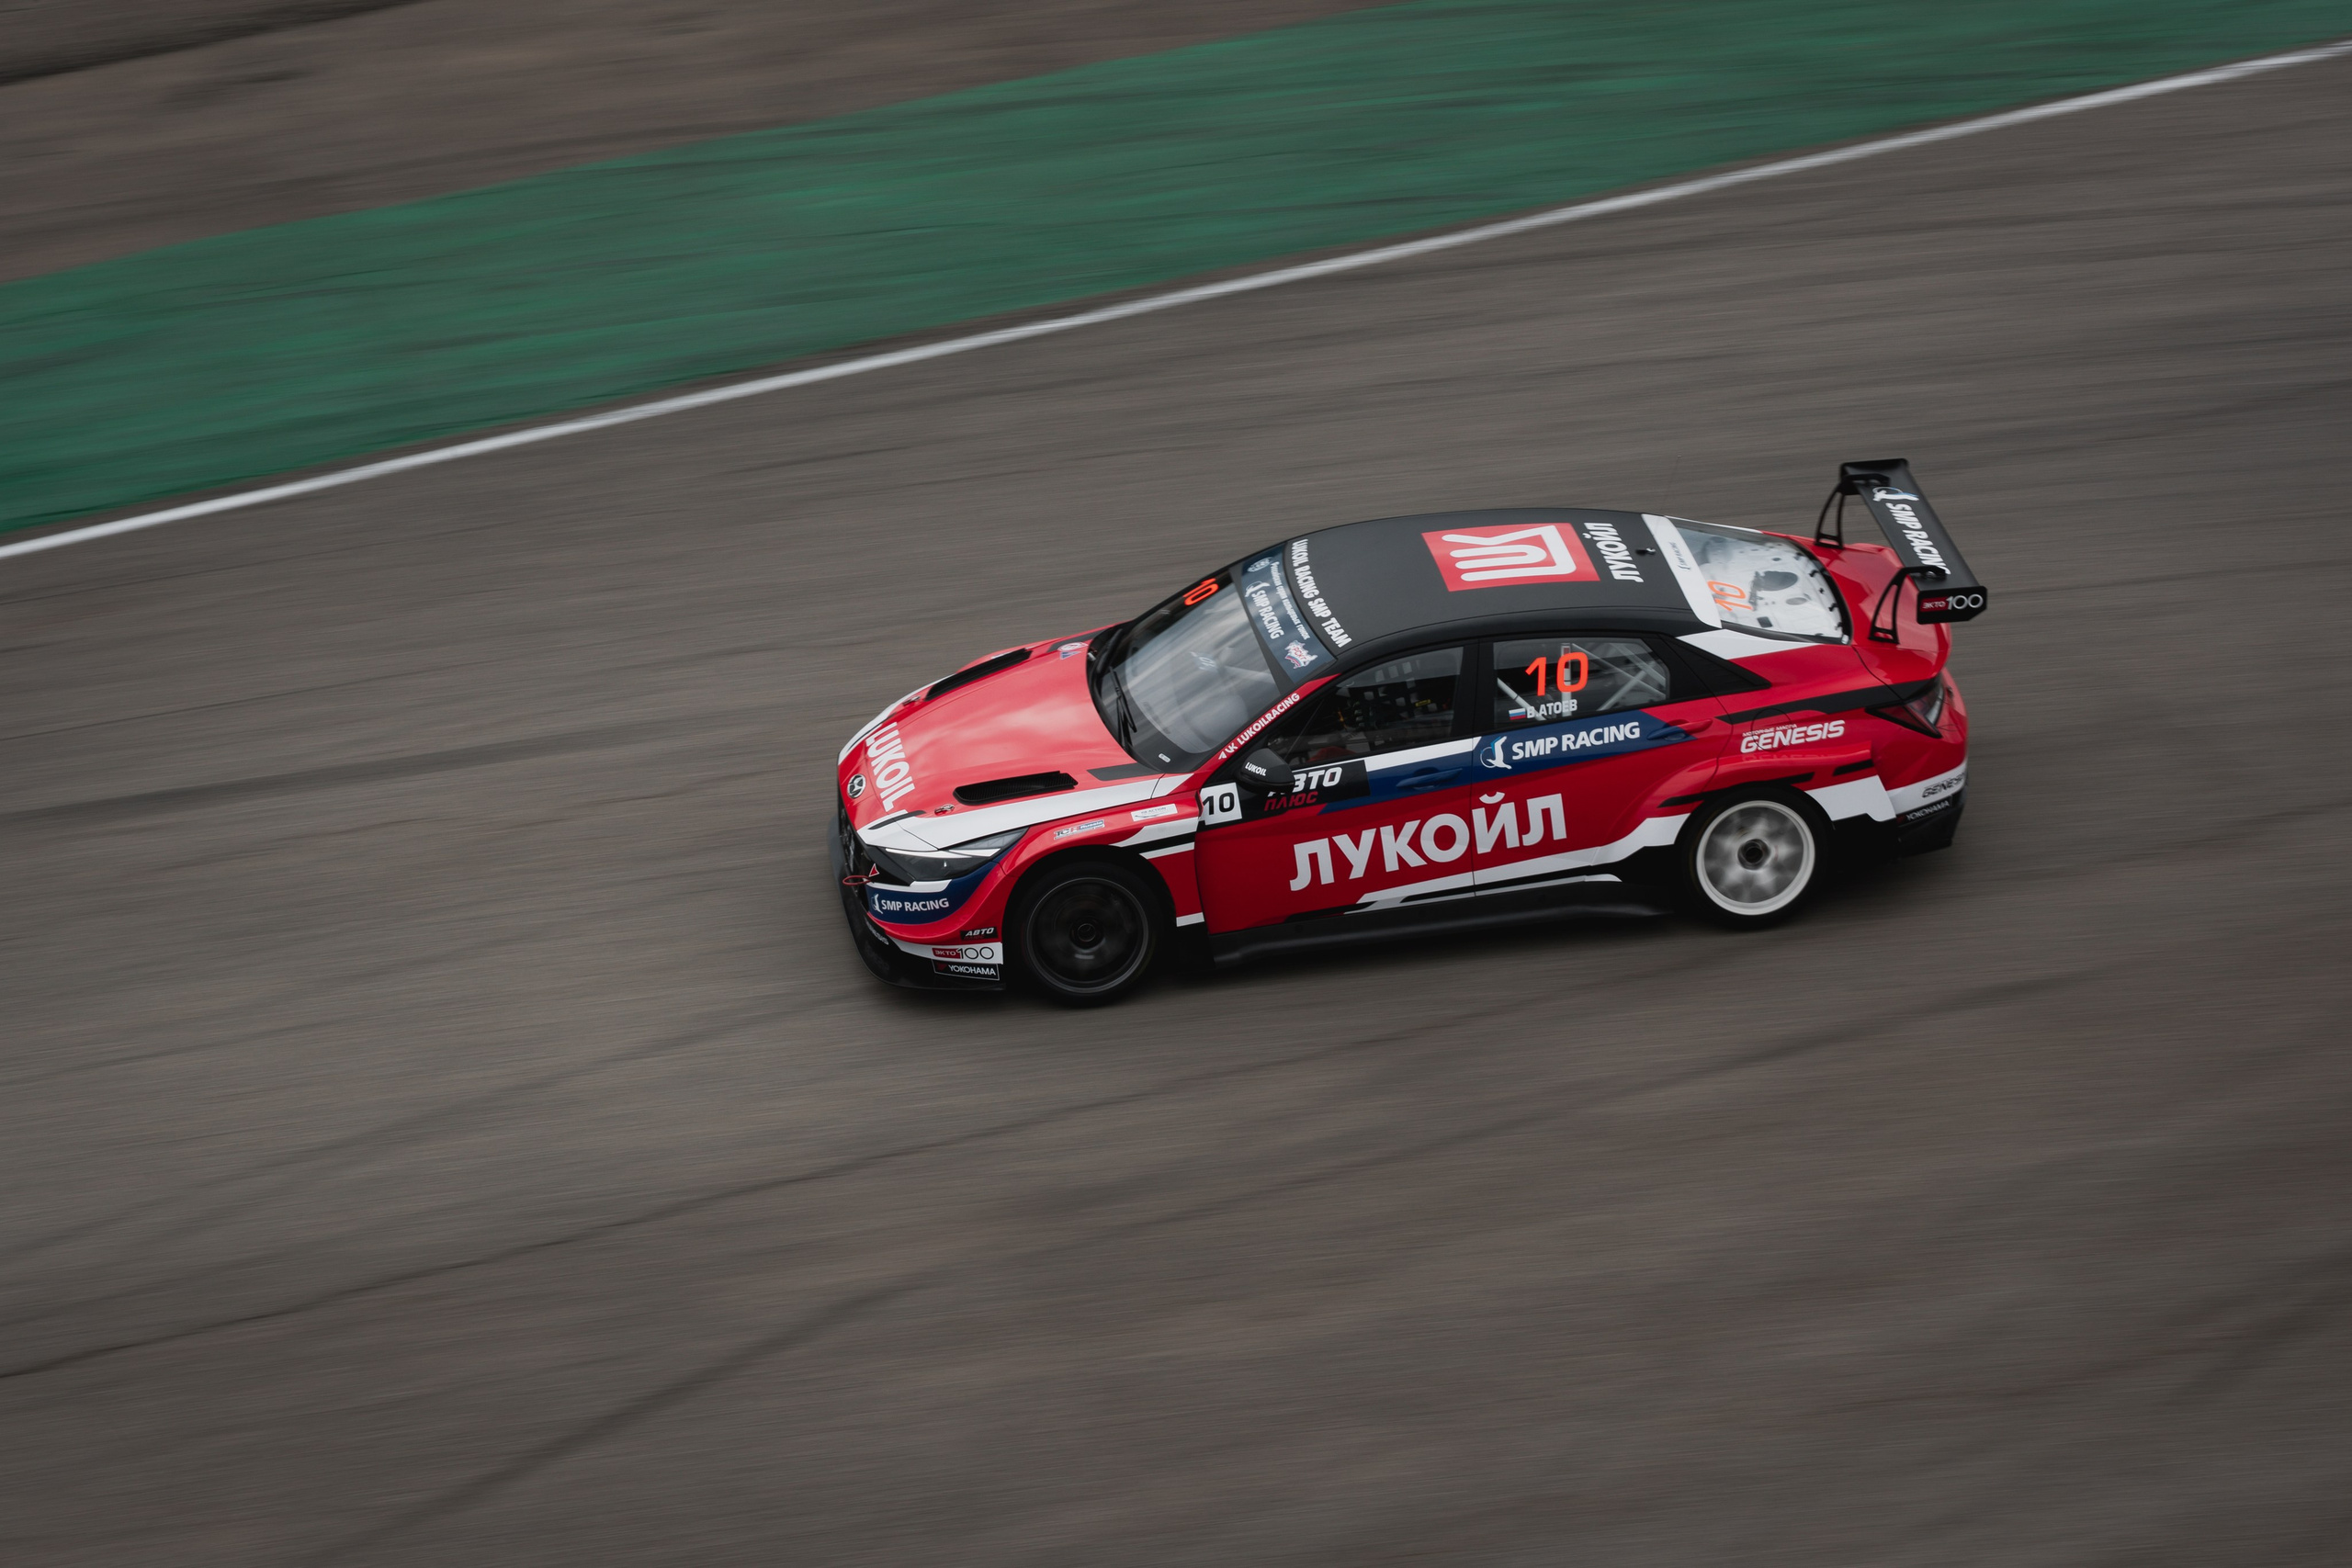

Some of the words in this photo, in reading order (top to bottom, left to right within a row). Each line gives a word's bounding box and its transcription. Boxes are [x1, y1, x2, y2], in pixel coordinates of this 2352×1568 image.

[1885, 502, 1923, 530] SMP
[1582, 522, 1645, 583] ЛУКОЙЛ
[1902, 529, 1951, 575] RACIN
[1182, 578, 1219, 605] 10
[1251, 590, 1270, 607] SMP
[1294, 565, 1320, 599] RACING
[1307, 597, 1332, 618] SMP
[1321, 617, 1352, 648] TEAM
[1707, 581, 1754, 612] 10
[1946, 593, 1984, 611] 100
[1259, 605, 1284, 640] RACING
[1525, 651, 1589, 696] 10
[1237, 693, 1301, 745] LUKOILRACING
[1511, 736, 1559, 761] SMP
[1561, 721, 1641, 751] RACING
[1740, 719, 1846, 753] GENESIS
[865, 721, 916, 813] LUKOIL
[1245, 761, 1267, 776] LUKOIL
[1267, 766, 1342, 797] ВТО
[1202, 792, 1235, 816] 10
[1289, 791, 1567, 893] ЛУКОЙЛ
[881, 899, 902, 911] SMP
[904, 897, 950, 912] RACING
[965, 927, 995, 937] АВТО
[957, 946, 995, 960] 100
[948, 964, 997, 976] YOKOHAMA
